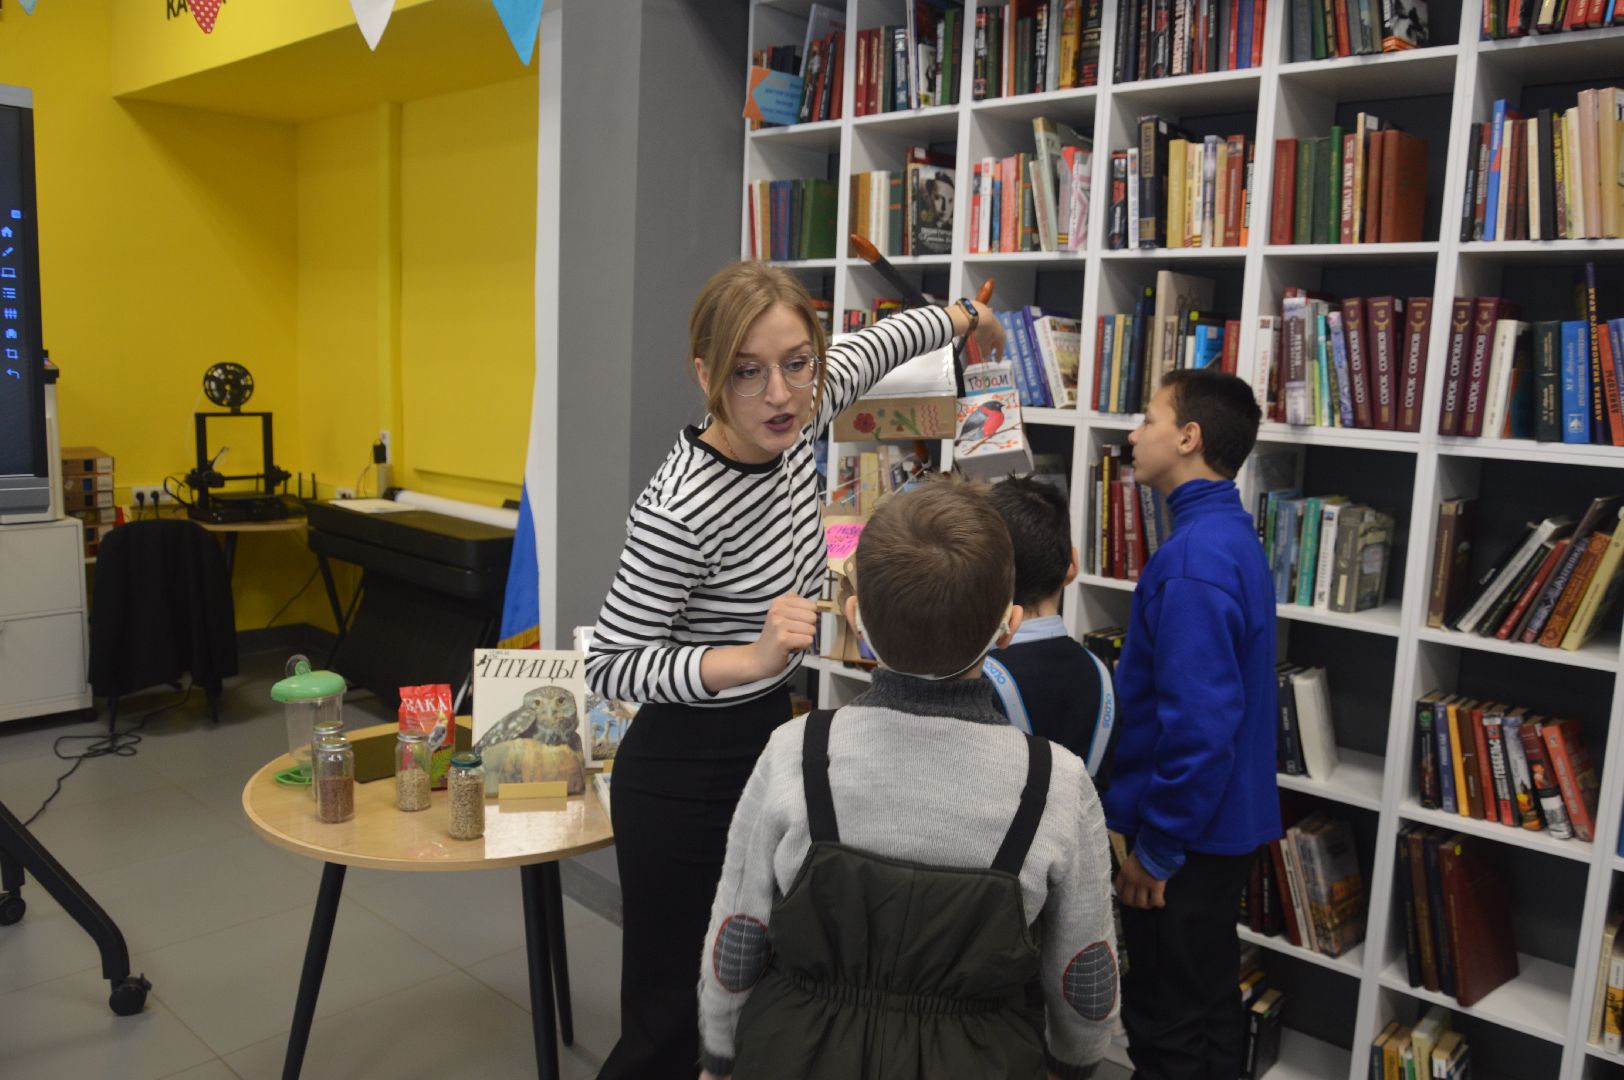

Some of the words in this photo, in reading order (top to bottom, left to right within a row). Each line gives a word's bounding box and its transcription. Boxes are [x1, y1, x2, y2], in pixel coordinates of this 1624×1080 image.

[1349, 331, 1360, 371] СОРОКОВ
[1378, 331, 1389, 372] СОРОКОВ
[1408, 333, 1421, 374] СОРОКОВ
[1450, 333, 1464, 376] СОРОКОВ
[1472, 334, 1487, 378] СОРОКОВ
[1353, 374, 1365, 404] СОРОК
[1379, 374, 1389, 405] СОРОК
[1405, 377, 1416, 408] СОРОК
[1445, 379, 1458, 411] СОРОК
[1466, 380, 1480, 413] СОРОК
[480, 658, 580, 684] ПТИЦЫ
